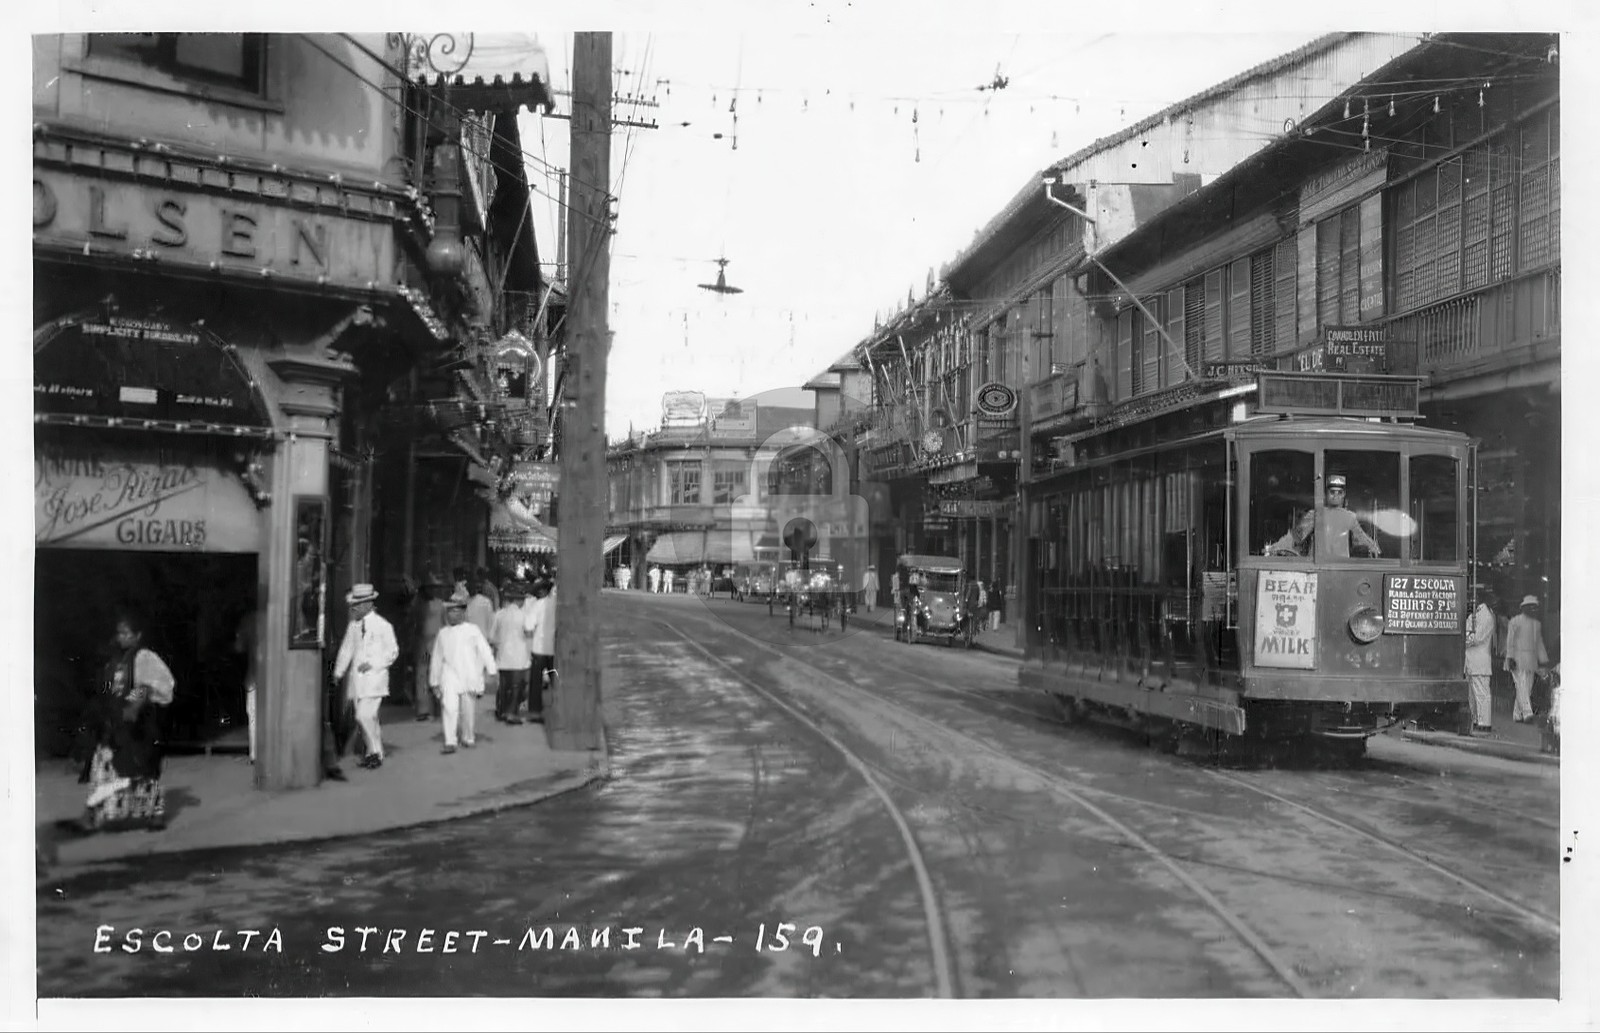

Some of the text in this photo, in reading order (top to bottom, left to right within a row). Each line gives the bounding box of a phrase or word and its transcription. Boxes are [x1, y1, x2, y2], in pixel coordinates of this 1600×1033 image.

[1352, 341, 1385, 356] ESTATE
[1390, 577, 1456, 591] 127 ESCOLTA
[1391, 598, 1434, 611] SHIRTS
[1260, 635, 1310, 655] MILK
